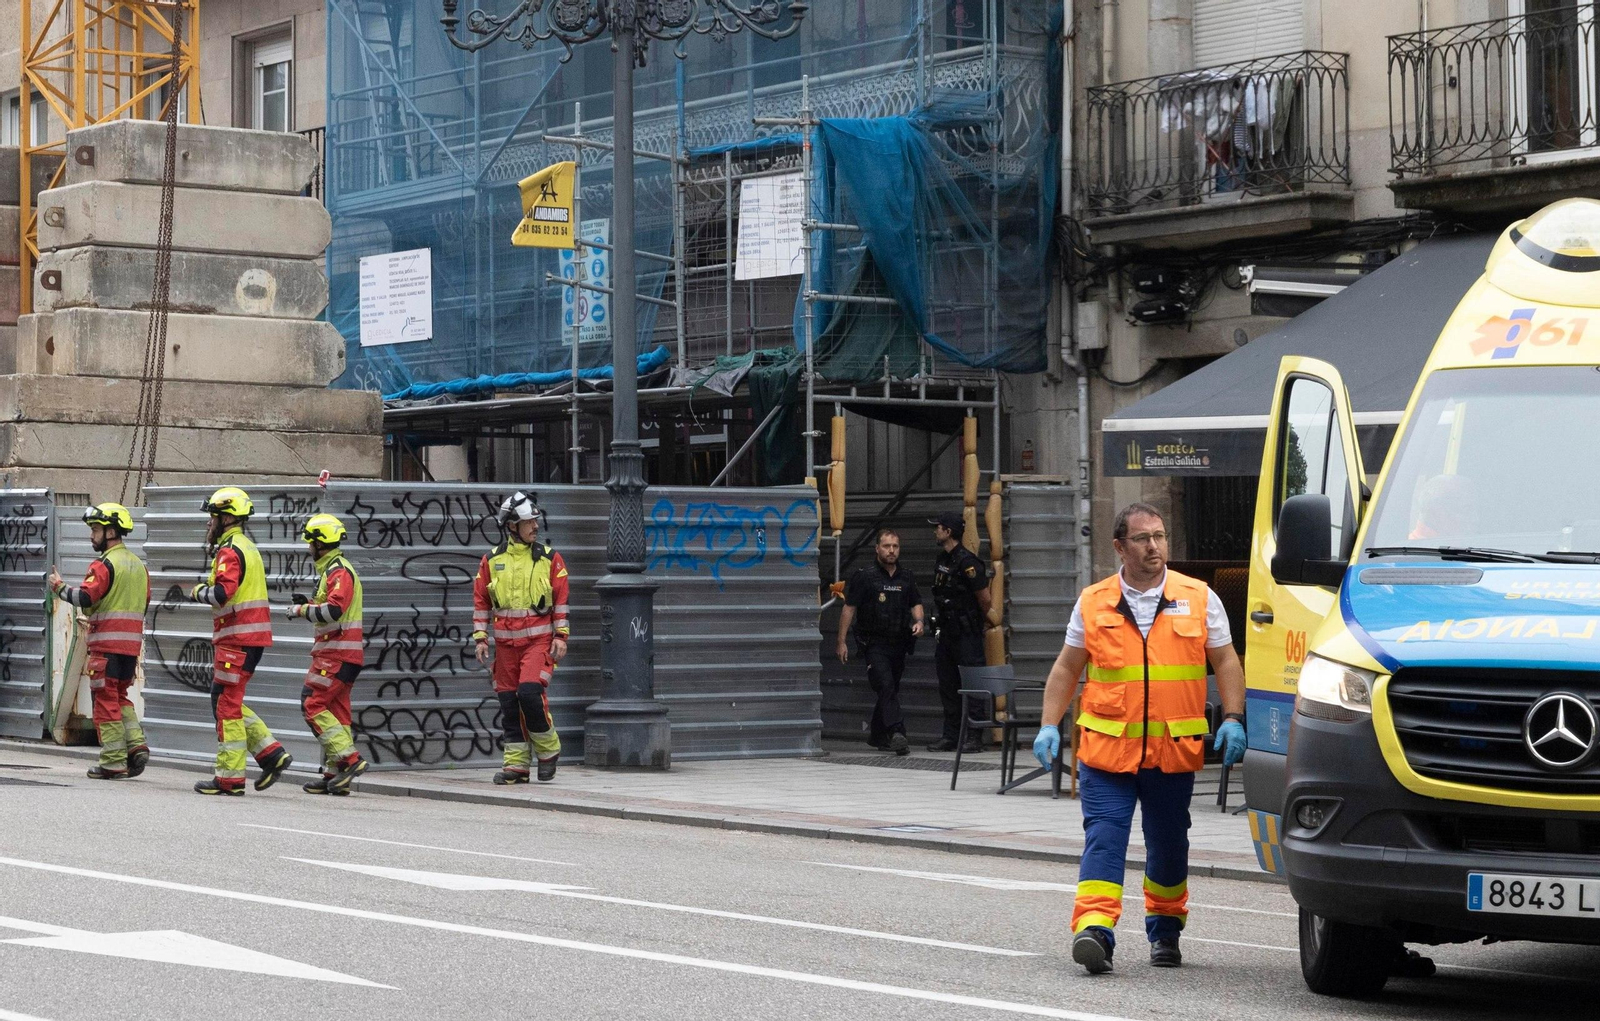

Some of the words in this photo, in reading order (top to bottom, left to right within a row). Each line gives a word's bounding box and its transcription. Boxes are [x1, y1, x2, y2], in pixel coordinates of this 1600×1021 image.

[534, 207, 568, 222] ANDAMIOS
[531, 224, 541, 234] 635
[543, 225, 550, 235] 62
[552, 226, 559, 235] 23
[560, 226, 568, 236] 54
[1503, 318, 1590, 348] 061
[1156, 445, 1196, 454] BODEGA
[1144, 456, 1174, 466] Estrella
[1175, 455, 1201, 466] Galicia
[1511, 581, 1600, 589] URXE
[1286, 629, 1307, 663] 061
[1472, 895, 1479, 904] E
[1489, 879, 1565, 911] 8843
[1579, 883, 1600, 913] L
